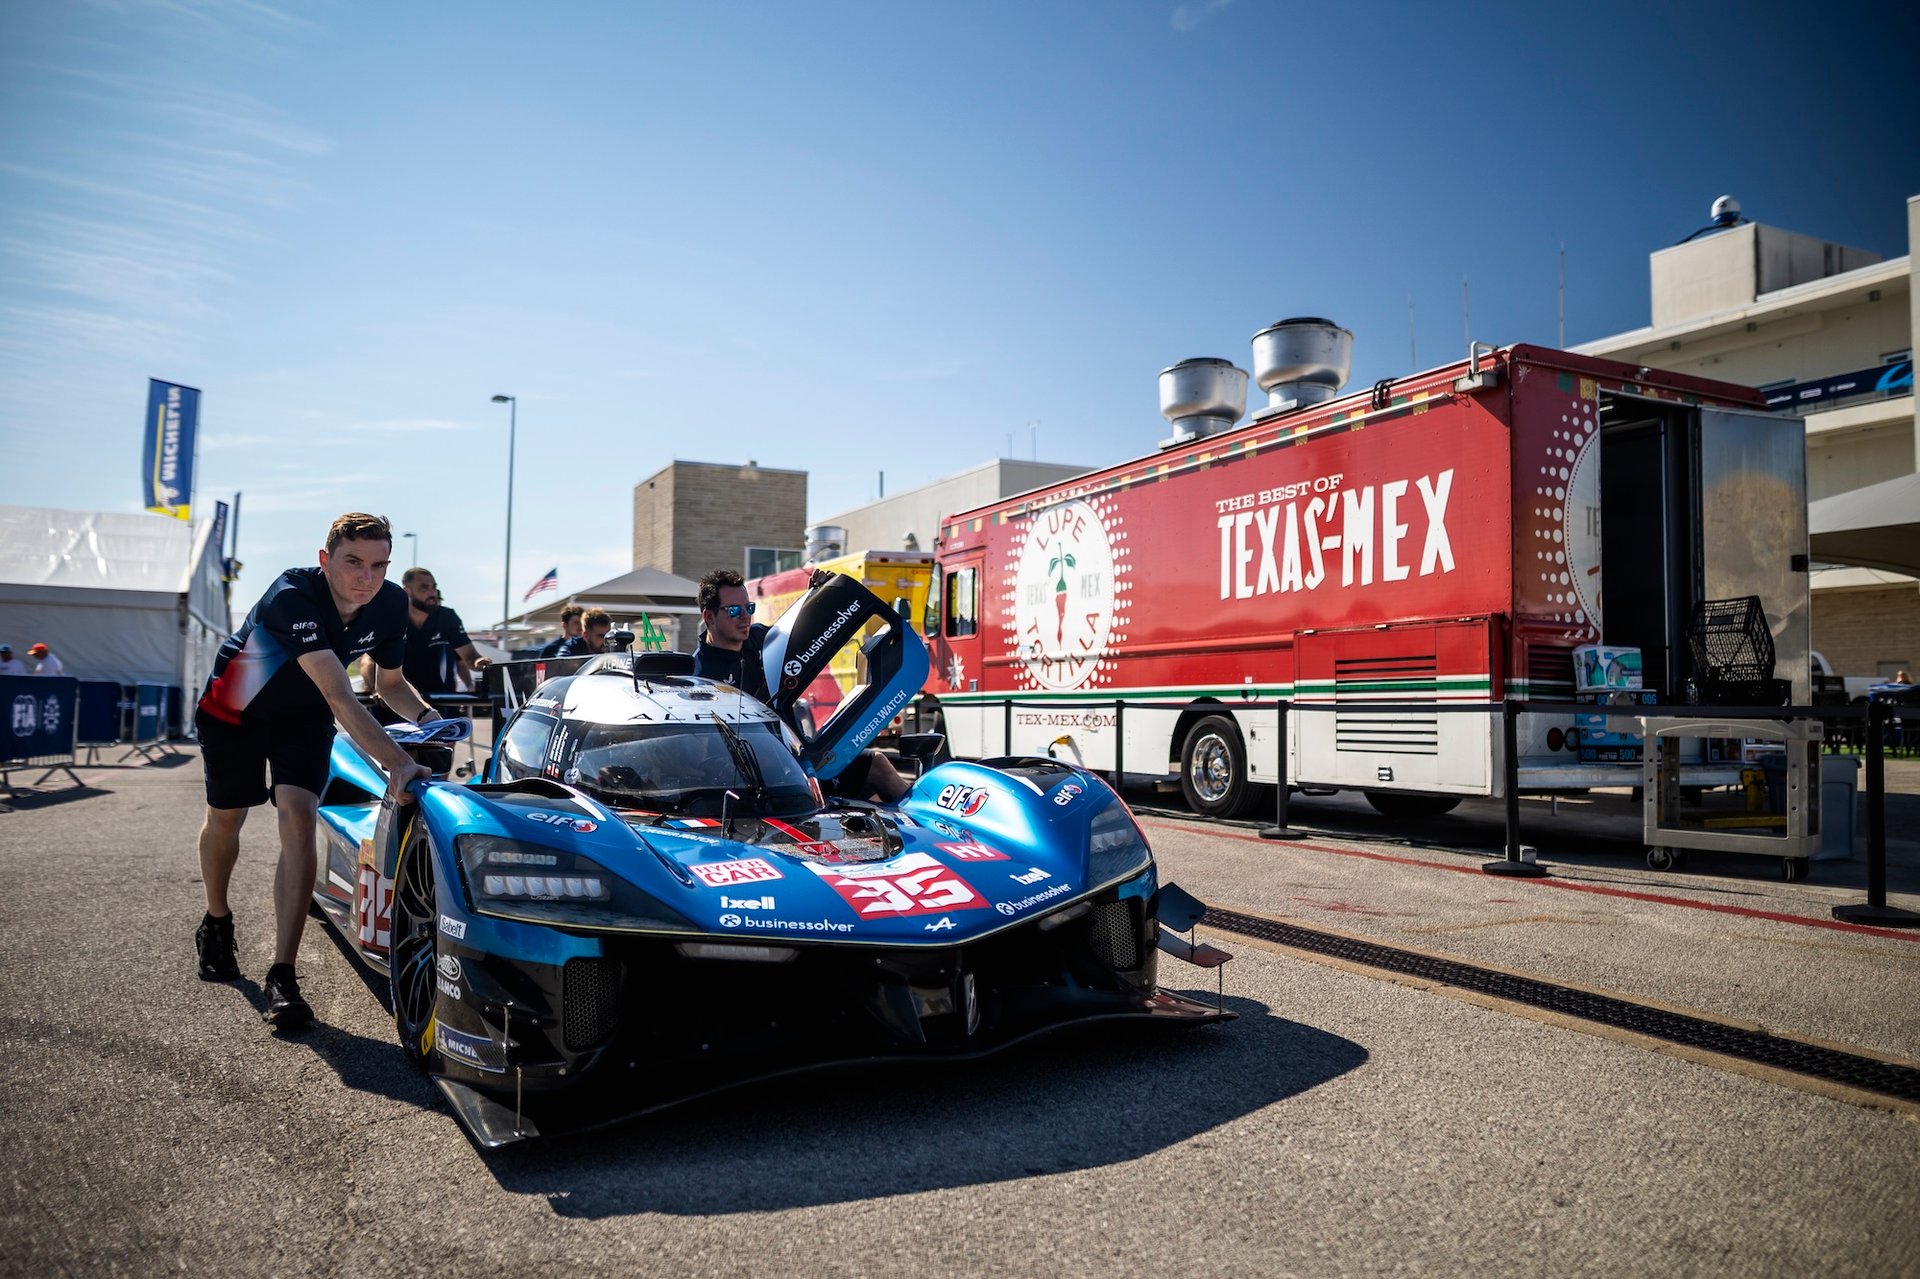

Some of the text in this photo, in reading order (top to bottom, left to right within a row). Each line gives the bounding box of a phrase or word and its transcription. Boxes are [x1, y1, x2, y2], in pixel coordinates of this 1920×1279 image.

[1216, 473, 1344, 514] THE BEST OF
[1036, 508, 1086, 551] LUPE
[1081, 573, 1101, 599] MEX
[292, 622, 307, 630] elf
[796, 599, 862, 664] businessolver
[601, 658, 632, 670] ALPINE
[628, 708, 781, 721] ALPINE
[936, 784, 973, 811] elf
[1053, 786, 1074, 806] elf
[527, 811, 573, 828] elf
[943, 845, 996, 859] HY
[696, 859, 764, 874] HYPER
[705, 867, 776, 884] CAR
[1009, 867, 1052, 886] ixell
[834, 868, 976, 914] 35
[1013, 882, 1071, 911] businessolver
[720, 896, 776, 910] ixell
[441, 917, 463, 937] Sabelt
[745, 914, 855, 932] businessolver
[448, 1038, 478, 1058] MICHE
